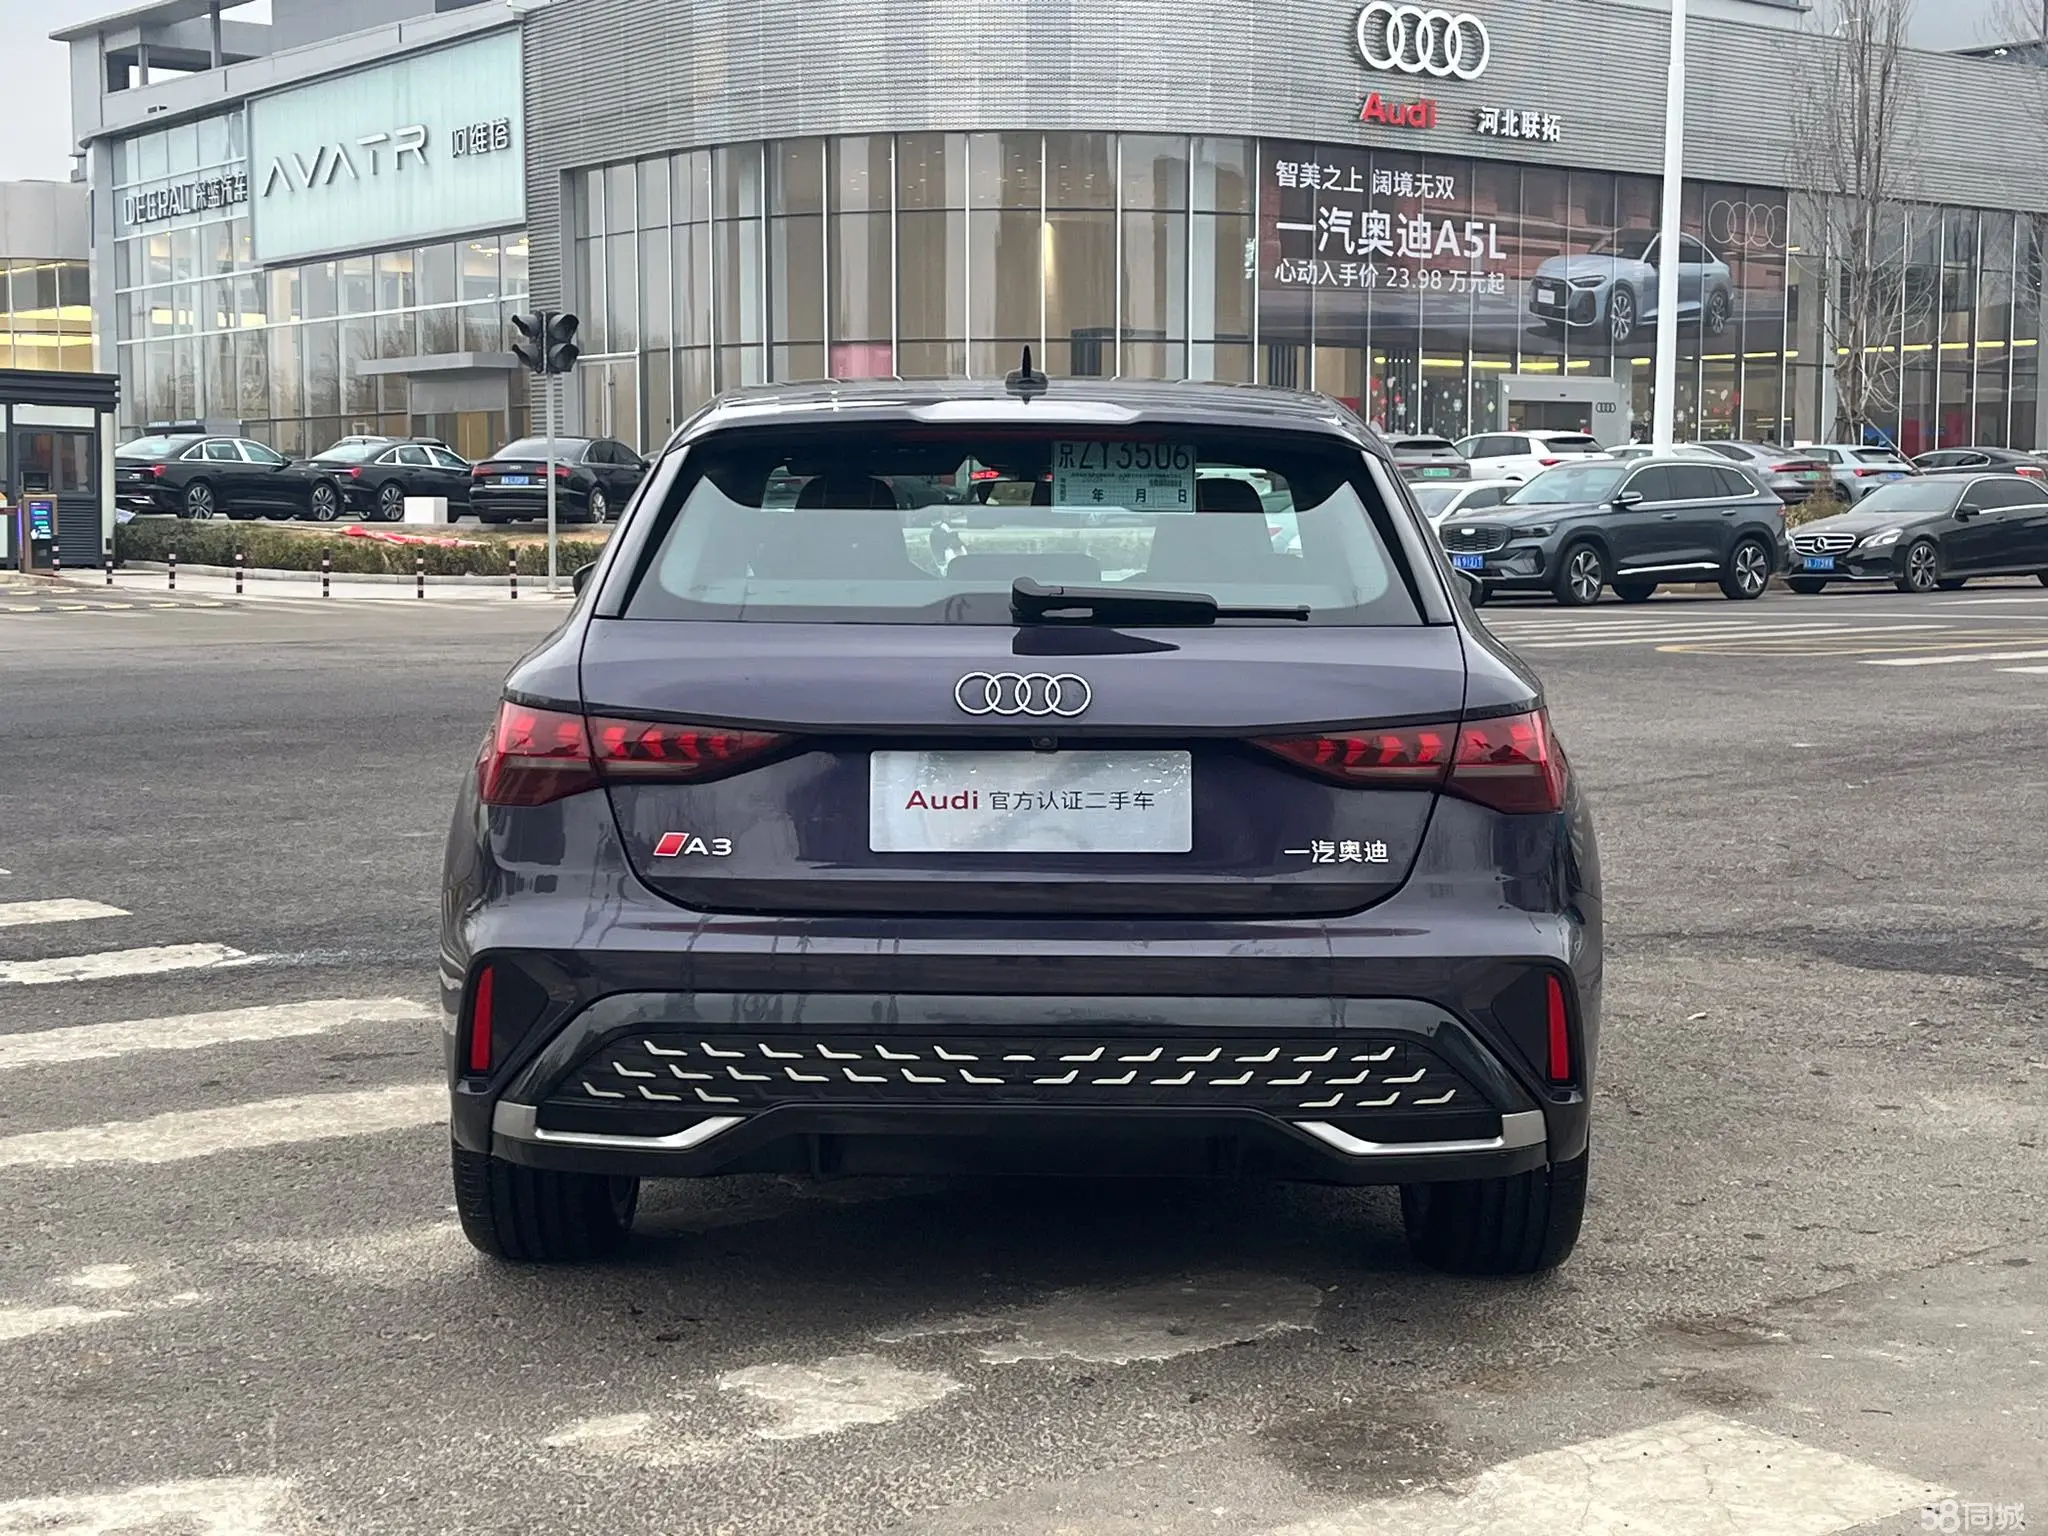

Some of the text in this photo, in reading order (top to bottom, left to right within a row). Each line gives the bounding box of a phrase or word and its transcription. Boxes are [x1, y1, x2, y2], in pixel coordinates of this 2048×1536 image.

[1360, 91, 1438, 129] Audi
[1477, 105, 1562, 142] 河北联拓
[263, 117, 510, 197] AVATR 阿维塔
[1275, 160, 1456, 200] 智美之上 阔境无双
[123, 184, 191, 225] DEEPAL
[1276, 206, 1507, 260] 一汽奥迪A5L
[1274, 258, 1379, 288] 心动入手价
[1386, 266, 1442, 290] 23.98
[1449, 269, 1505, 295] 万元起
[1091, 487, 1188, 504] 年 月 日
[905, 790, 1155, 811] Audi 官方认证二手车
[684, 837, 732, 856] A3
[1284, 840, 1389, 863] 一汽奥迪
